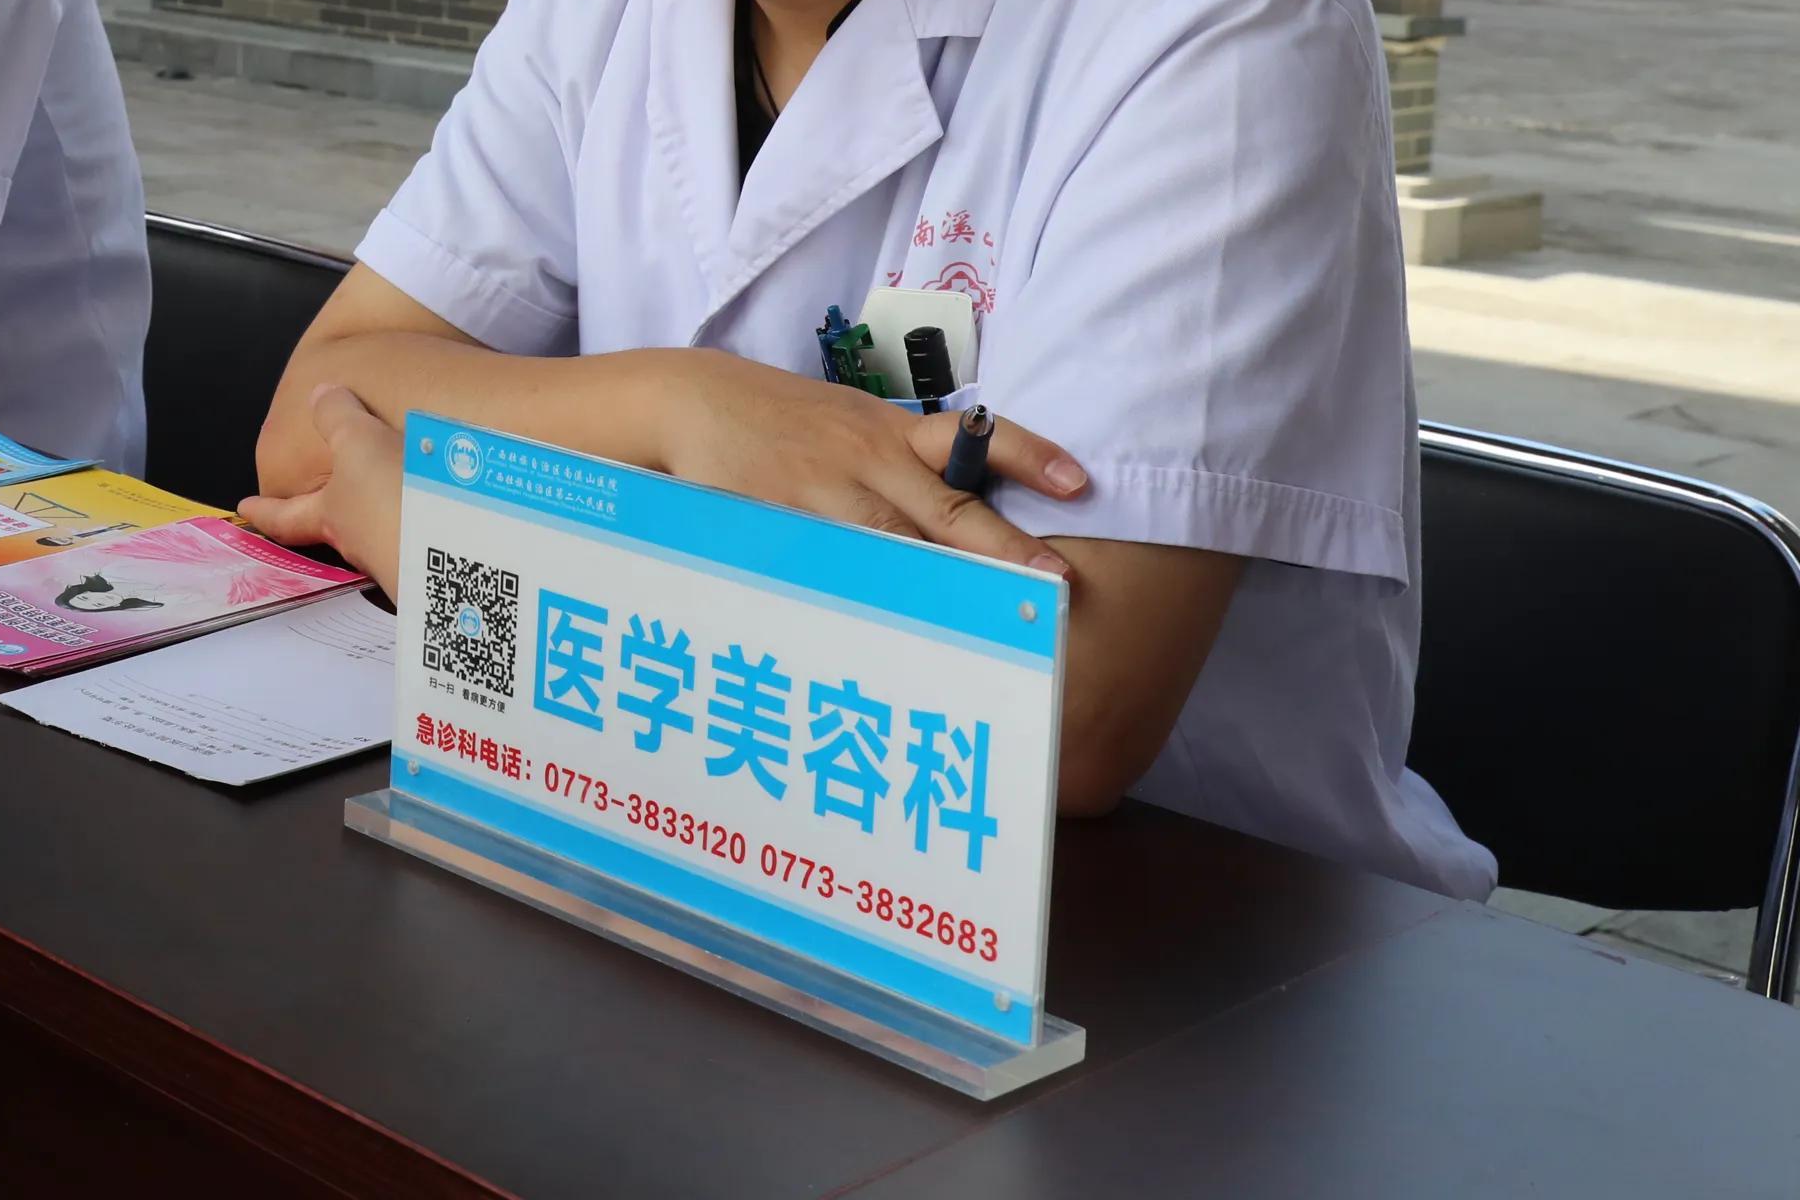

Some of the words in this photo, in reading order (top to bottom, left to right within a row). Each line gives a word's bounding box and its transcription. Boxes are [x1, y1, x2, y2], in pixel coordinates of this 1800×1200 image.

[429, 676, 455, 695] 扫一扫
[462, 688, 505, 714] 看病更方便
[533, 588, 999, 872] 医学美容科
[544, 762, 747, 865] 0773-3833120
[760, 844, 999, 963] 0773-3832683
